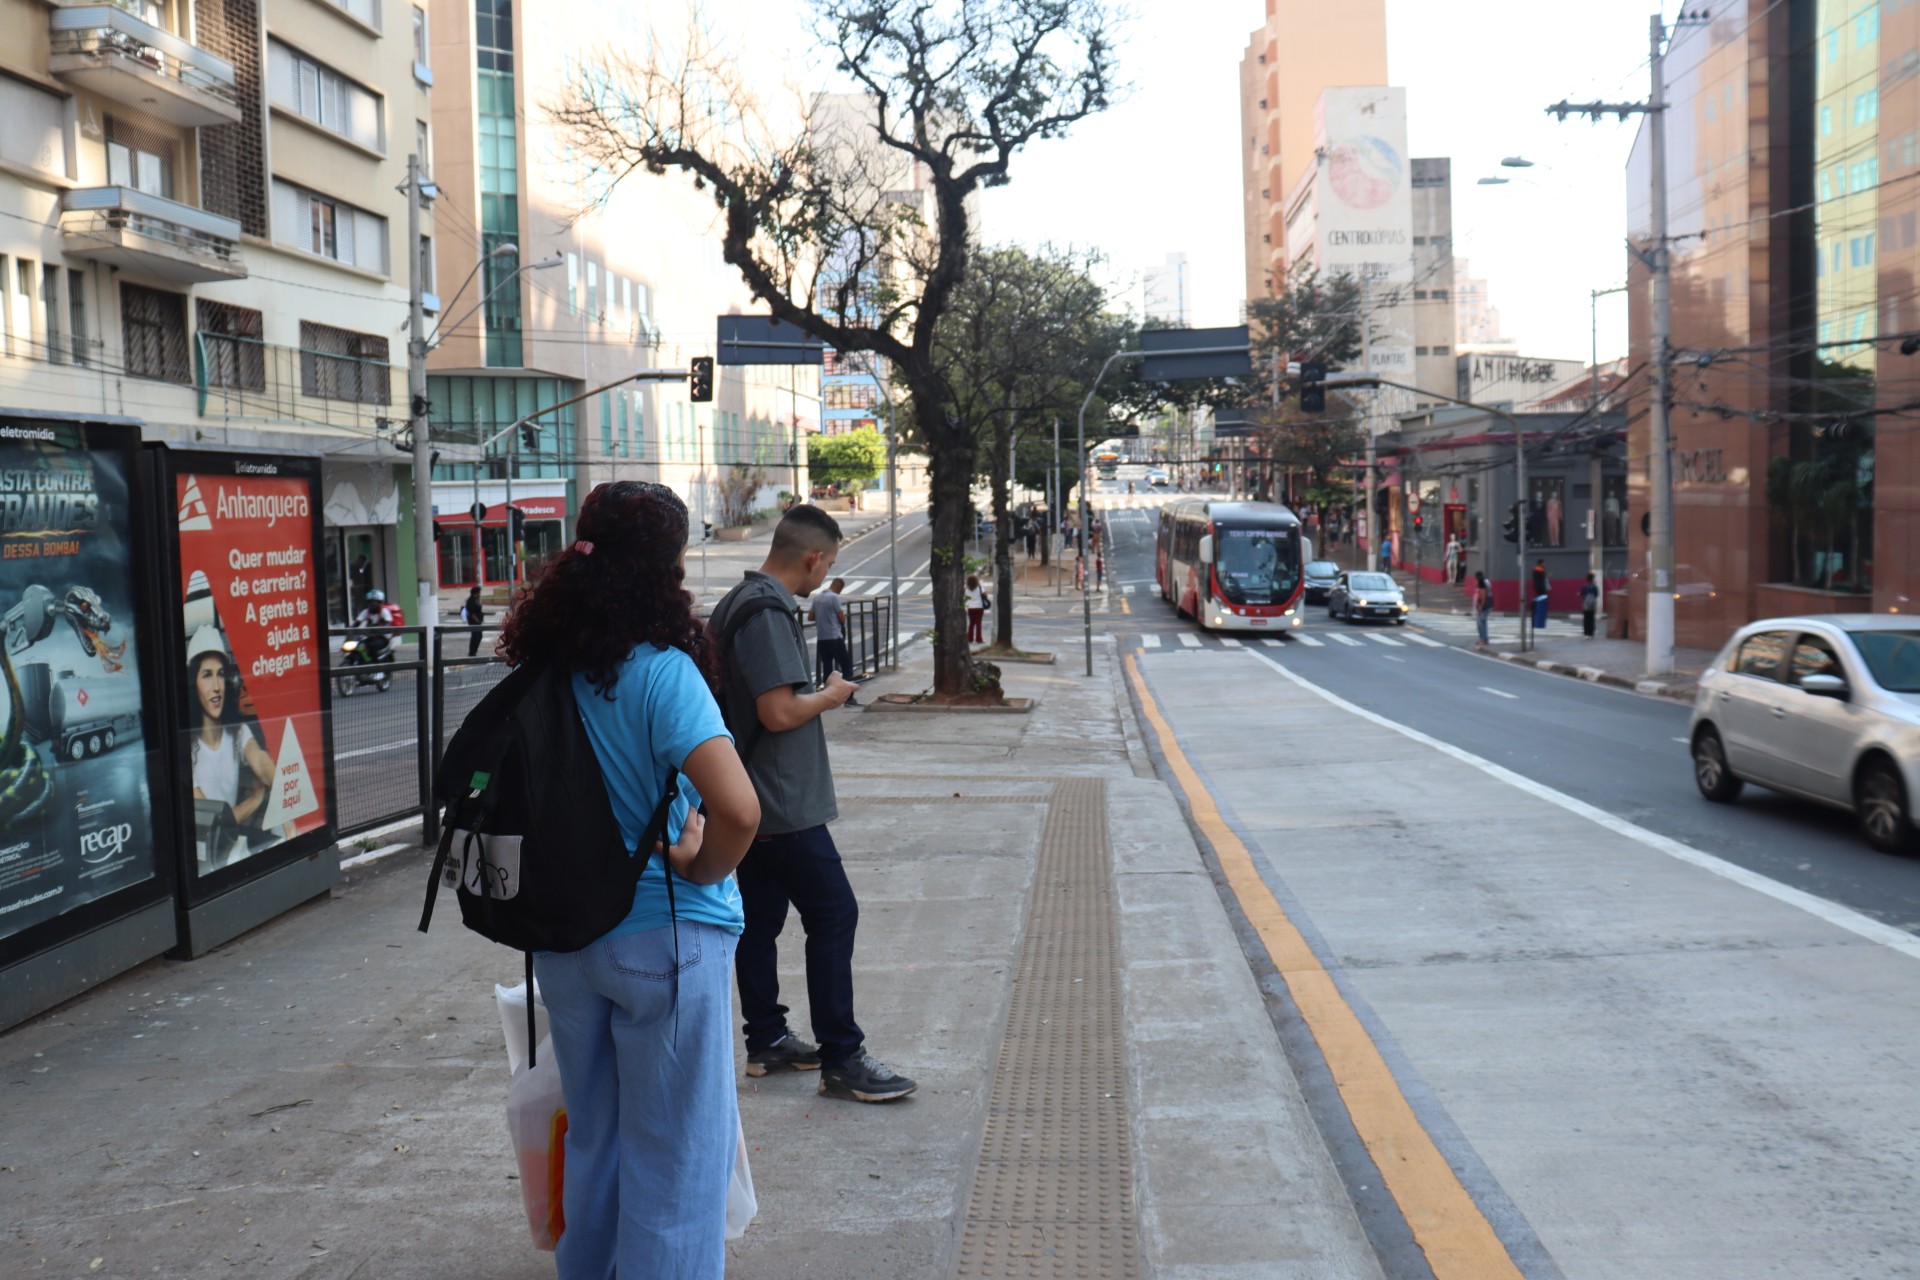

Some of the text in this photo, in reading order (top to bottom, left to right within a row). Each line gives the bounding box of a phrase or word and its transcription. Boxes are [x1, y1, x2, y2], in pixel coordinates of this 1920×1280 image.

[1371, 353, 1406, 366] PLANTAS
[35, 469, 91, 491] CONTRA
[216, 485, 309, 527] Anhanguera
[3, 541, 79, 559] DESSA BOMBA!
[229, 546, 306, 569] Quer mudar
[230, 570, 307, 597] de carreira?
[245, 597, 309, 627] A gente te
[267, 625, 310, 650] ajuda a
[252, 648, 311, 677] chegar lá.
[281, 762, 300, 776] vem
[283, 779, 299, 795] por
[282, 790, 301, 809] aqui
[80, 822, 132, 855] recap
